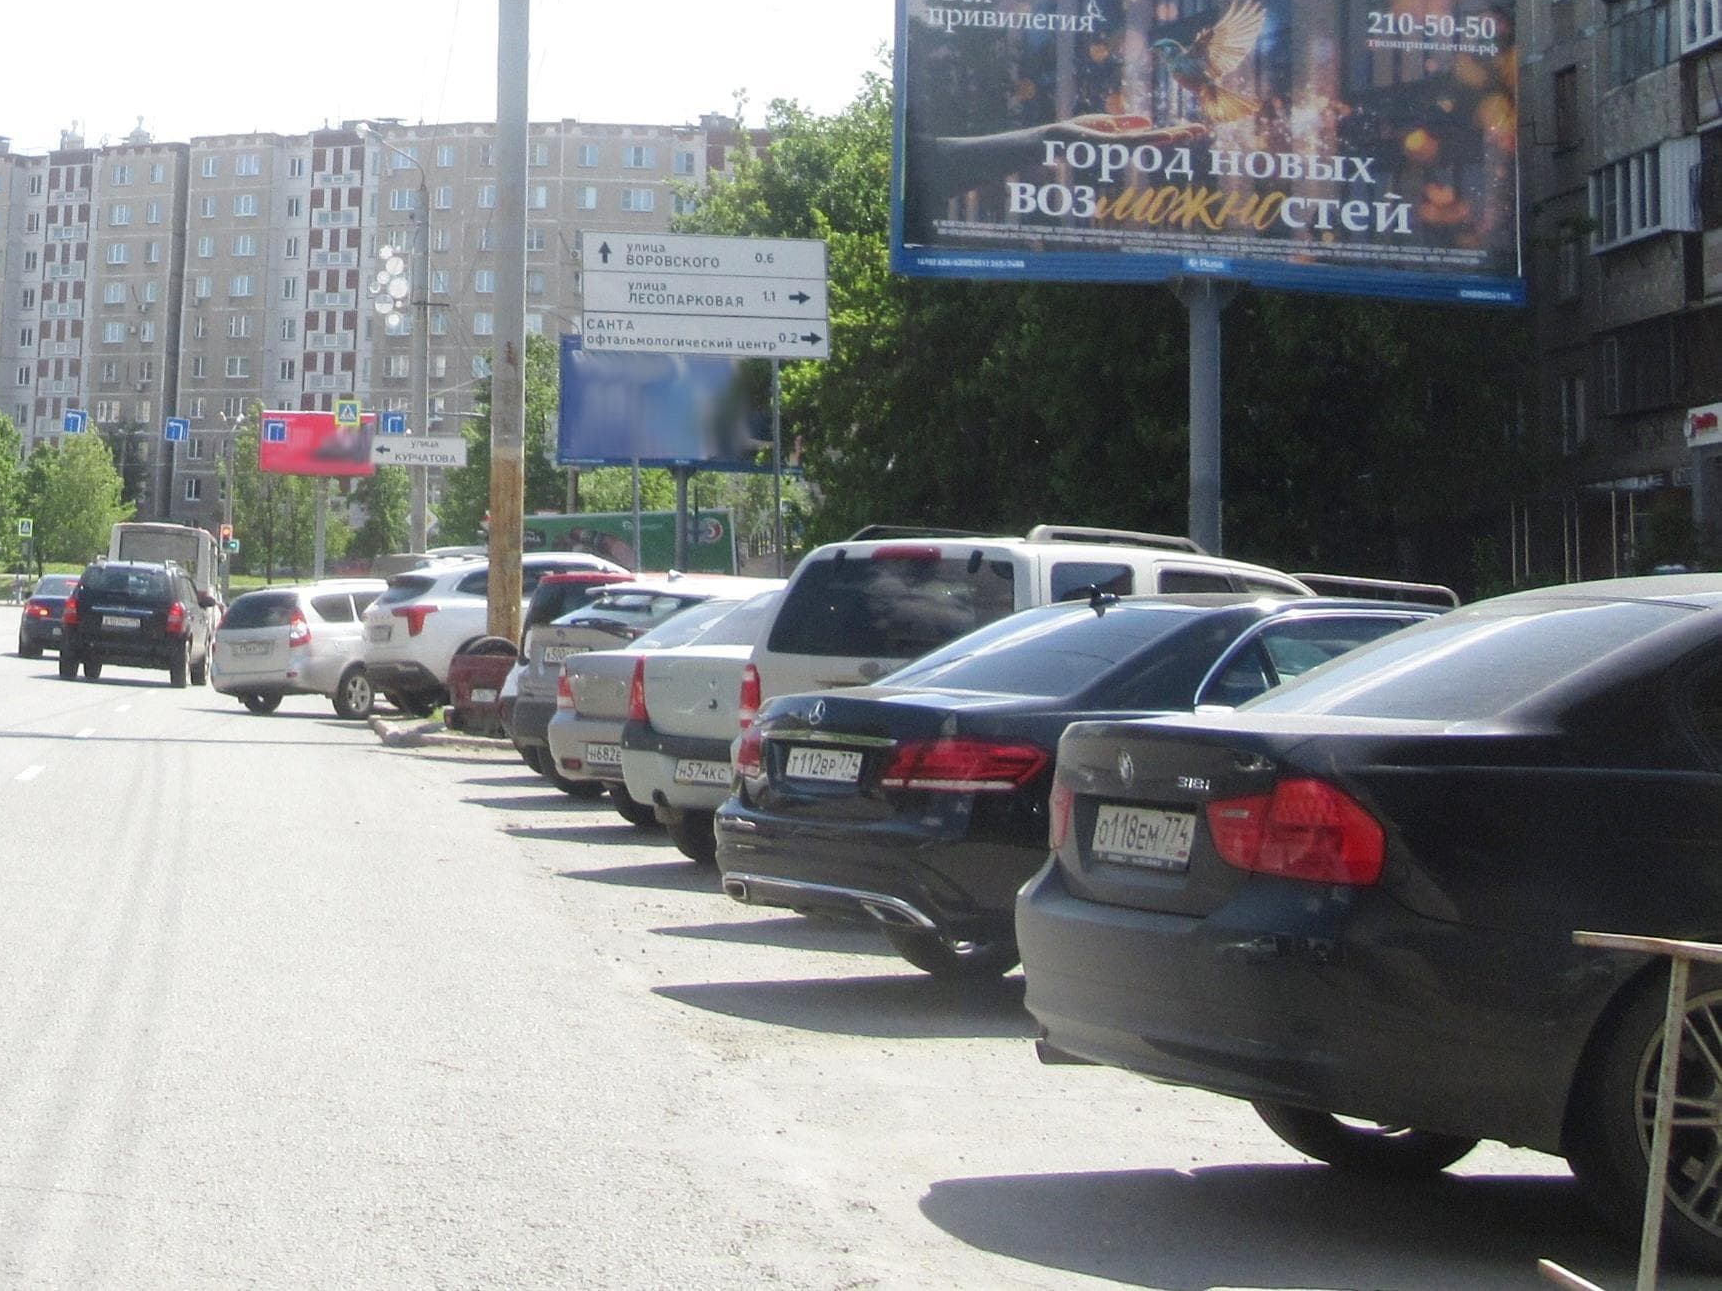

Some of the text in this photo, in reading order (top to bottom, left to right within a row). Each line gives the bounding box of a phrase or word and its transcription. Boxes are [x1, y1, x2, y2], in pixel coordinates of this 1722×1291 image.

[928, 7, 1094, 33] привилегия
[1367, 11, 1496, 39] 210-50-50
[1042, 140, 1376, 183] город новых
[1007, 181, 1412, 234] возможностей
[626, 243, 665, 254] улица
[626, 253, 774, 268] ВОРОВСКОГО 0.6
[628, 282, 666, 293] улица
[628, 291, 776, 308] ЛЕСОПАРКОВАЯ 1.1
[587, 319, 634, 331] САНТА
[587, 333, 798, 351] офтальмологический центр 0.2
[395, 453, 456, 463] КУРЧАТОВА
[589, 746, 621, 761] Н682Е
